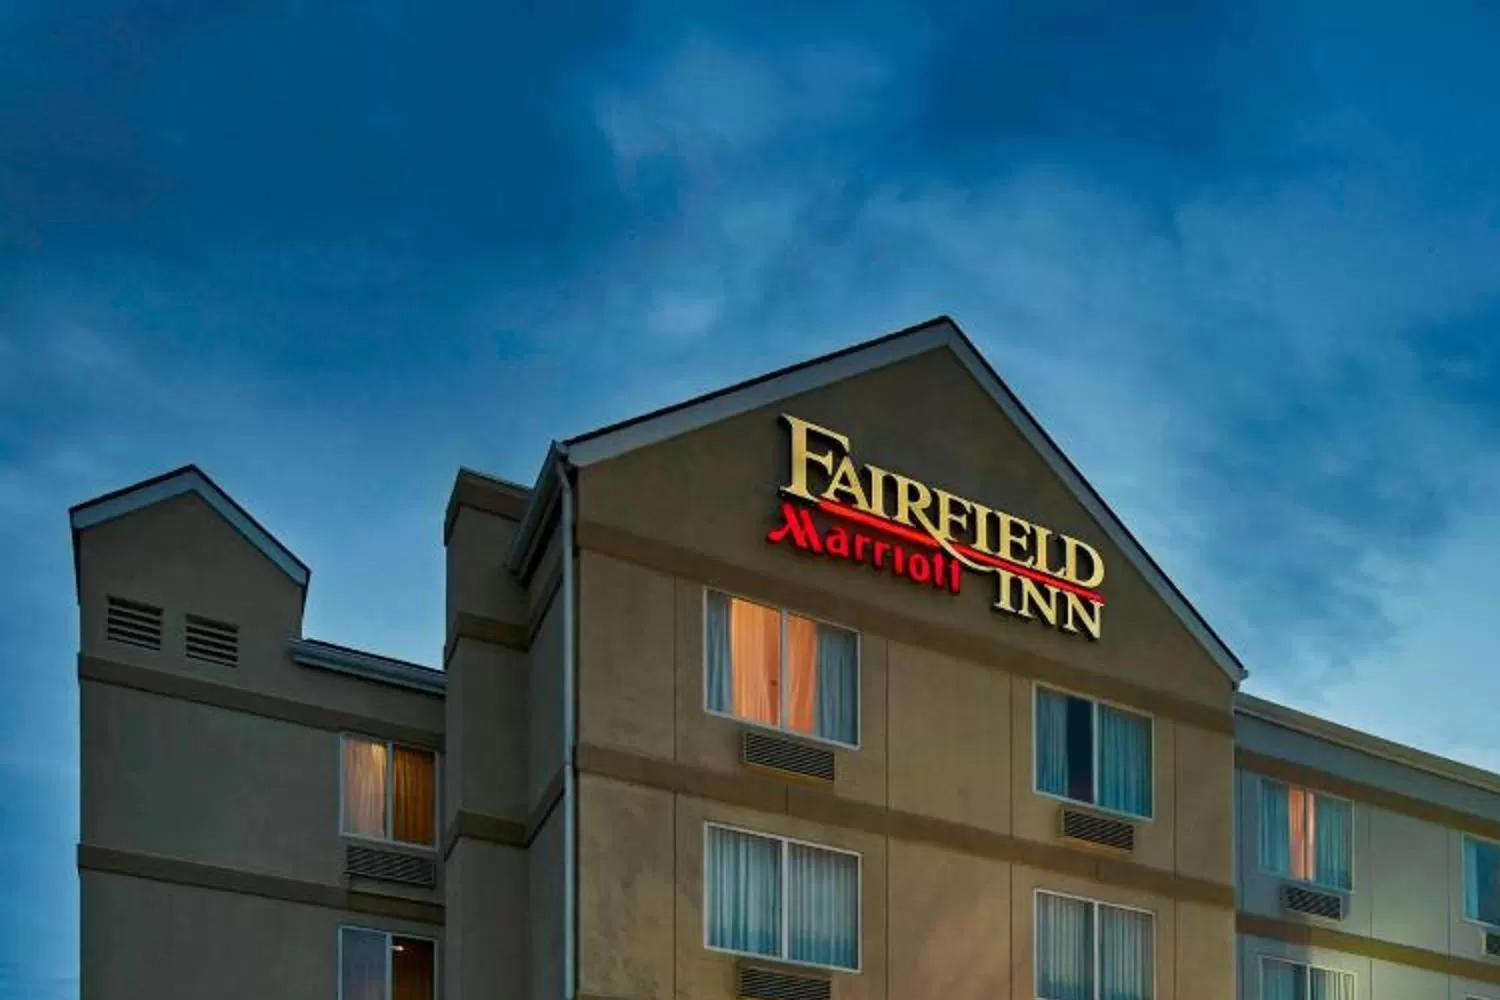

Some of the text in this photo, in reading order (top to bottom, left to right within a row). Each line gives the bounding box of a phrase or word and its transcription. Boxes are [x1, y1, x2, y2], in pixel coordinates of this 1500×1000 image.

[779, 412, 1105, 588] FAIRFIELD
[766, 503, 962, 594] Marriott
[993, 569, 1105, 640] INN
